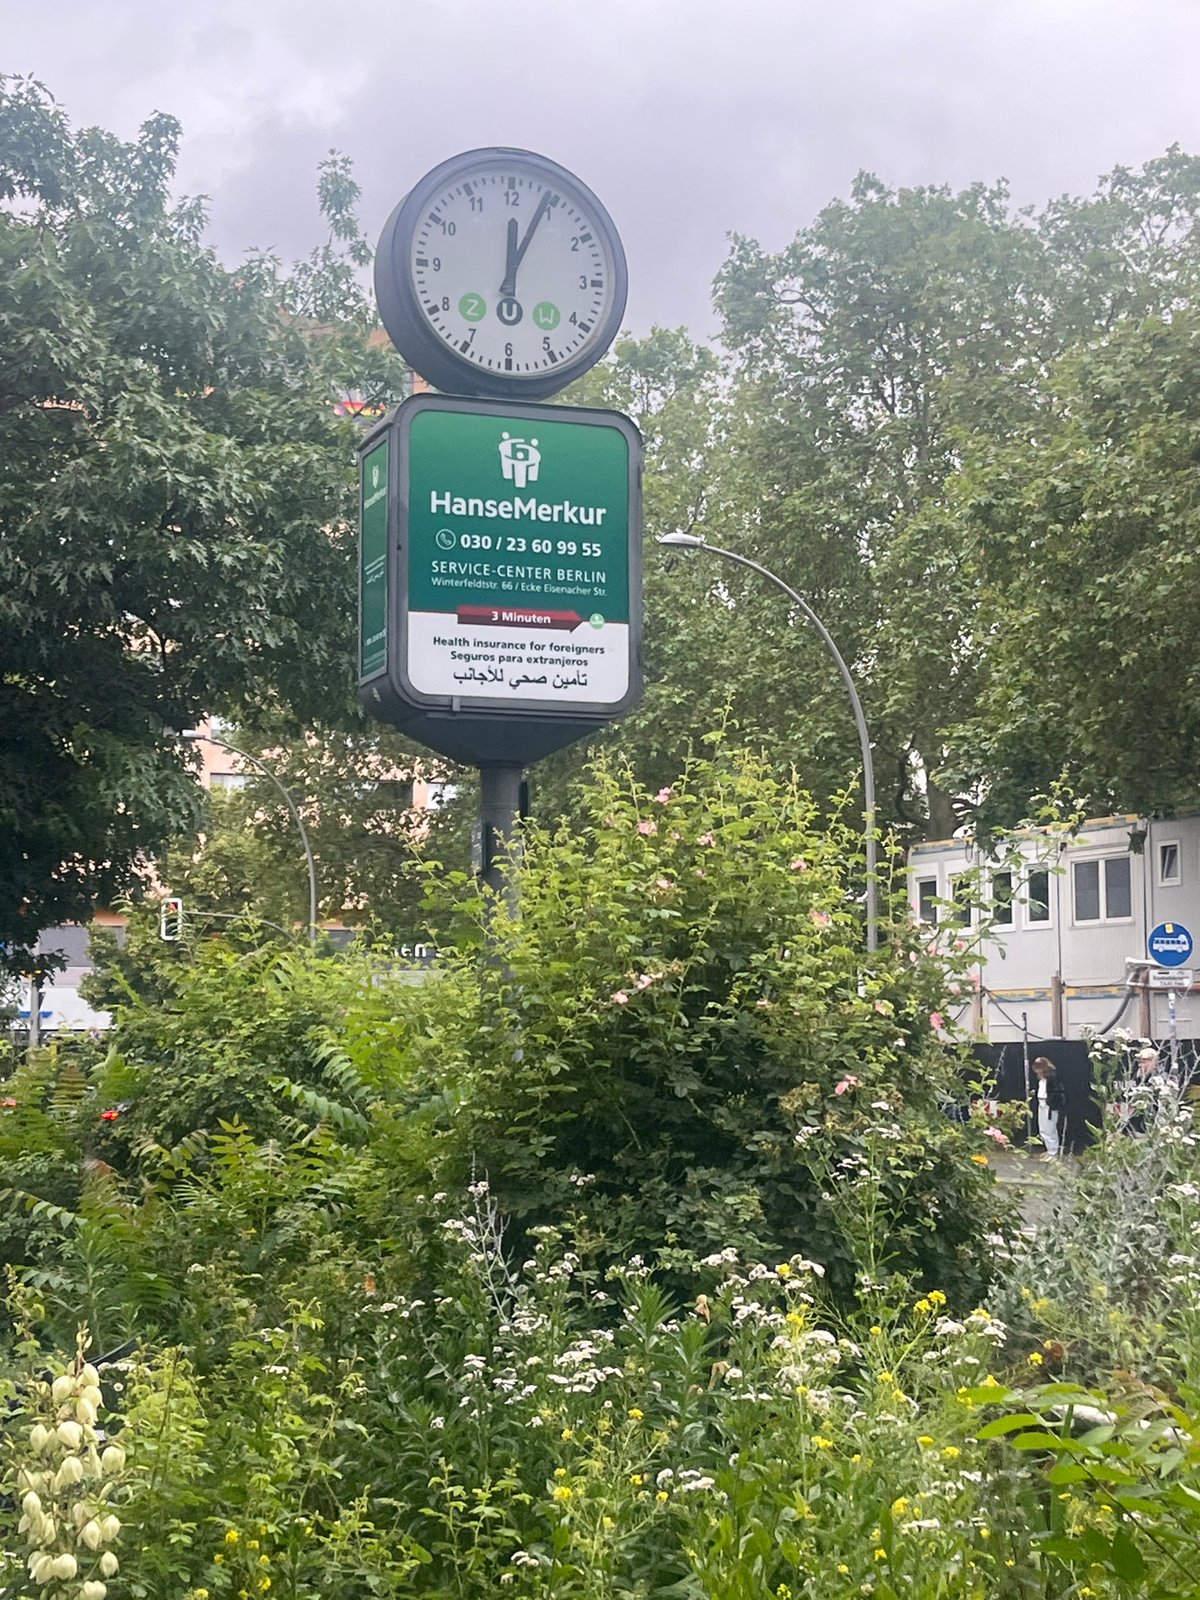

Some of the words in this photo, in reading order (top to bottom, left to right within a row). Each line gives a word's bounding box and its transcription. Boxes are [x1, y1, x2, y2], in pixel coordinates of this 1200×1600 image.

[469, 197, 483, 212] 11
[504, 192, 520, 206] 12
[545, 207, 552, 221] 1
[441, 221, 456, 236] 10
[570, 237, 579, 252] 2
[432, 258, 441, 272] 9
[579, 276, 588, 290] 3
[441, 297, 450, 311] 8
[465, 299, 480, 316] Z
[502, 302, 517, 321] U
[539, 307, 555, 325] W
[568, 311, 578, 326] 4
[468, 328, 477, 343] 7
[504, 343, 513, 357] 6
[542, 337, 551, 351] 5
[430, 490, 607, 526] HanseMerkur
[460, 534, 492, 550] 030
[496, 536, 503, 550] /
[506, 537, 526, 552] 23
[531, 539, 552, 554] 60
[557, 541, 577, 556] 99
[582, 542, 602, 557] 55
[431, 560, 552, 580] SERVICE-CENTER
[557, 568, 607, 584] BERLIN
[431, 577, 498, 590] Winterfeldtstr.
[501, 580, 513, 591] 66
[521, 581, 542, 593] Ecke
[544, 583, 592, 596] Eisenacher
[593, 587, 608, 597] Str.
[491, 611, 499, 621] 3
[502, 611, 551, 624] Minuten
[433, 636, 470, 648] Health
[473, 638, 526, 651] insurance
[530, 641, 546, 651] for
[549, 642, 605, 656] foreigners
[450, 651, 495, 663] Seguros
[498, 654, 523, 665] para
[526, 655, 588, 667] extranjeros
[453, 665, 504, 686] للأجانب
[508, 673, 547, 690] صحي
[552, 669, 588, 690] تأمين
